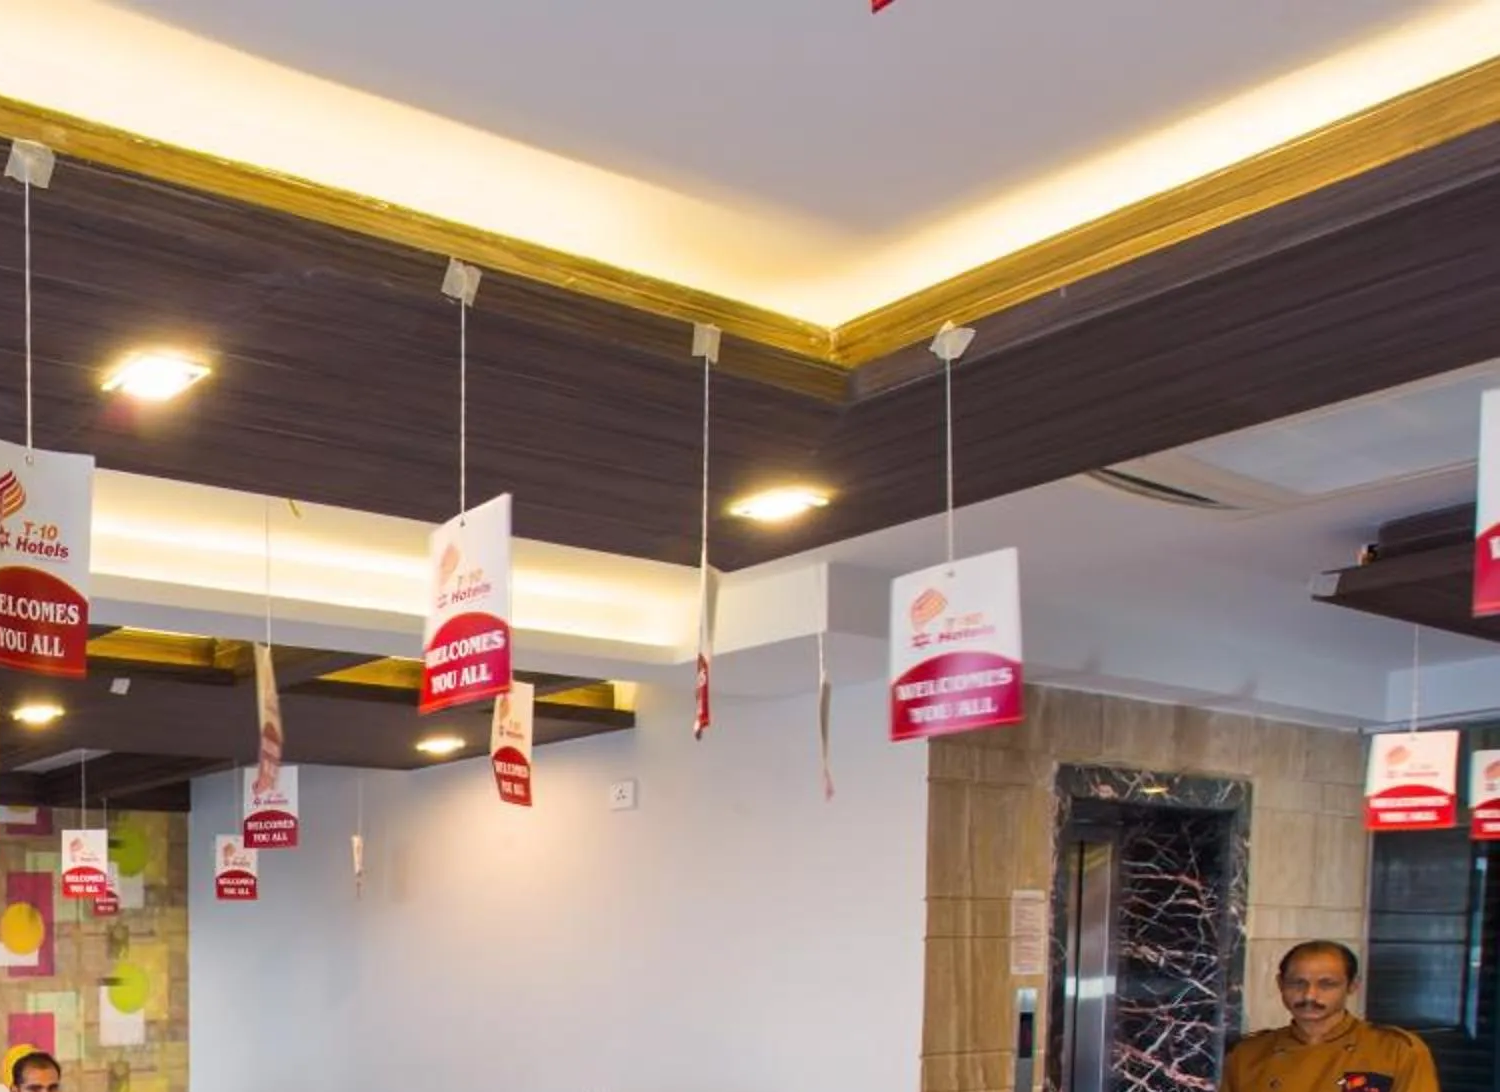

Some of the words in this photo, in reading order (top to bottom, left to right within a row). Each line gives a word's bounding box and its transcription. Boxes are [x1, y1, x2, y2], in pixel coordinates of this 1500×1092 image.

[23, 521, 58, 540] T-10
[16, 537, 69, 559] Hotels
[31, 634, 65, 657] ALL
[425, 630, 506, 669] WELCOMES
[431, 670, 457, 695] YOU
[460, 662, 493, 687] ALL
[897, 667, 1013, 701] WELCOMES
[909, 704, 949, 723] YOU
[954, 697, 998, 718] ALL
